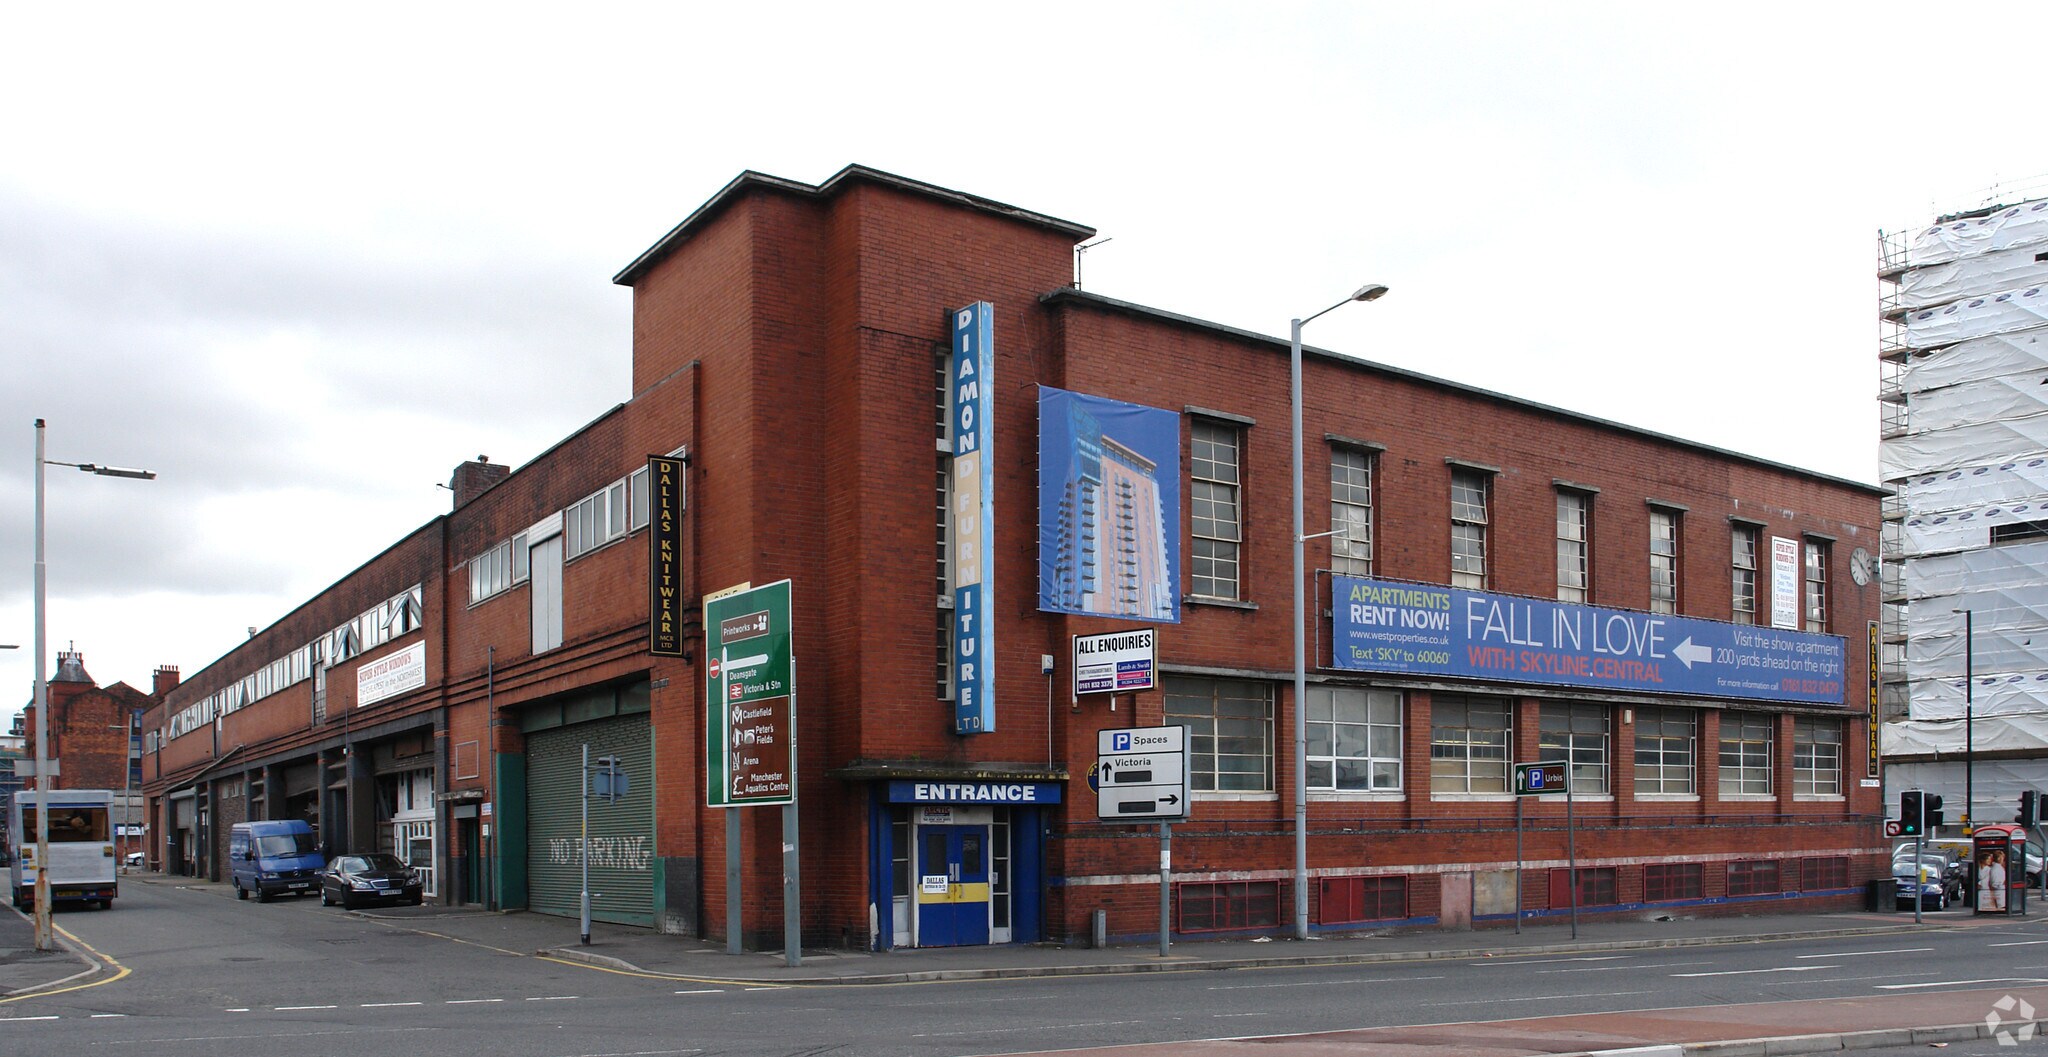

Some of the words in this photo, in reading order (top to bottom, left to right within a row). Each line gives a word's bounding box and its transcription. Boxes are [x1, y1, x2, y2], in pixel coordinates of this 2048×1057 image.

[958, 310, 978, 478] DIAMOND
[660, 462, 672, 532] DALLAS
[659, 539, 675, 633] KNITWEAR
[959, 493, 976, 706] FURNITURE
[1350, 585, 1451, 610] APARTMENTS
[1350, 604, 1397, 626] RENT
[1401, 609, 1450, 631] NOW!
[723, 624, 751, 637] Printworks
[1467, 597, 1543, 647] FALL
[1553, 608, 1580, 650] IN
[1594, 613, 1666, 658] LOVE
[659, 634, 674, 642] MCR
[661, 641, 673, 649] LTD
[1079, 640, 1095, 655] ALL
[1098, 634, 1151, 652] ENQUIRIES
[1350, 631, 1449, 645] www.westproperties.co.uk
[1733, 630, 1752, 647] Visit
[1755, 636, 1769, 650] the
[1771, 635, 1794, 652] show
[1796, 641, 1838, 657] apartment
[1350, 646, 1373, 660] Text
[1404, 651, 1415, 662] to
[1118, 663, 1131, 671] Lamb
[1137, 661, 1150, 669] Swift
[1467, 645, 1515, 671] WITH
[1520, 651, 1662, 682] SKYLINE.CENTRAL
[1717, 648, 1734, 664] 200
[1736, 650, 1759, 669] yards
[1762, 652, 1789, 669] ahead
[1791, 659, 1802, 671] on
[1804, 656, 1818, 673] the
[1819, 660, 1838, 678] right
[729, 668, 757, 681] Deansgate
[743, 683, 764, 694] Victoria
[766, 682, 770, 691] &
[771, 680, 781, 690] Stn
[1717, 678, 1726, 686] For
[1727, 680, 1740, 688] more
[1742, 680, 1769, 690] information
[1771, 682, 1779, 691] call
[743, 706, 772, 719] Castlefield
[756, 724, 773, 734] Peter's
[956, 716, 979, 731] LTD
[1870, 687, 1878, 759] KNITWEAR
[756, 734, 773, 745] Fields
[1117, 735, 1128, 749] P
[1134, 736, 1168, 746] Spaces
[743, 757, 759, 766] Arena
[1115, 758, 1151, 766] Victoria
[751, 772, 782, 782] Manchester
[1531, 772, 1541, 786] P
[1545, 774, 1563, 782] Urbis
[745, 784, 768, 794] Aquatics
[769, 782, 789, 792] Centre
[915, 783, 1036, 801] ENTRANCE
[550, 838, 570, 865] NO
